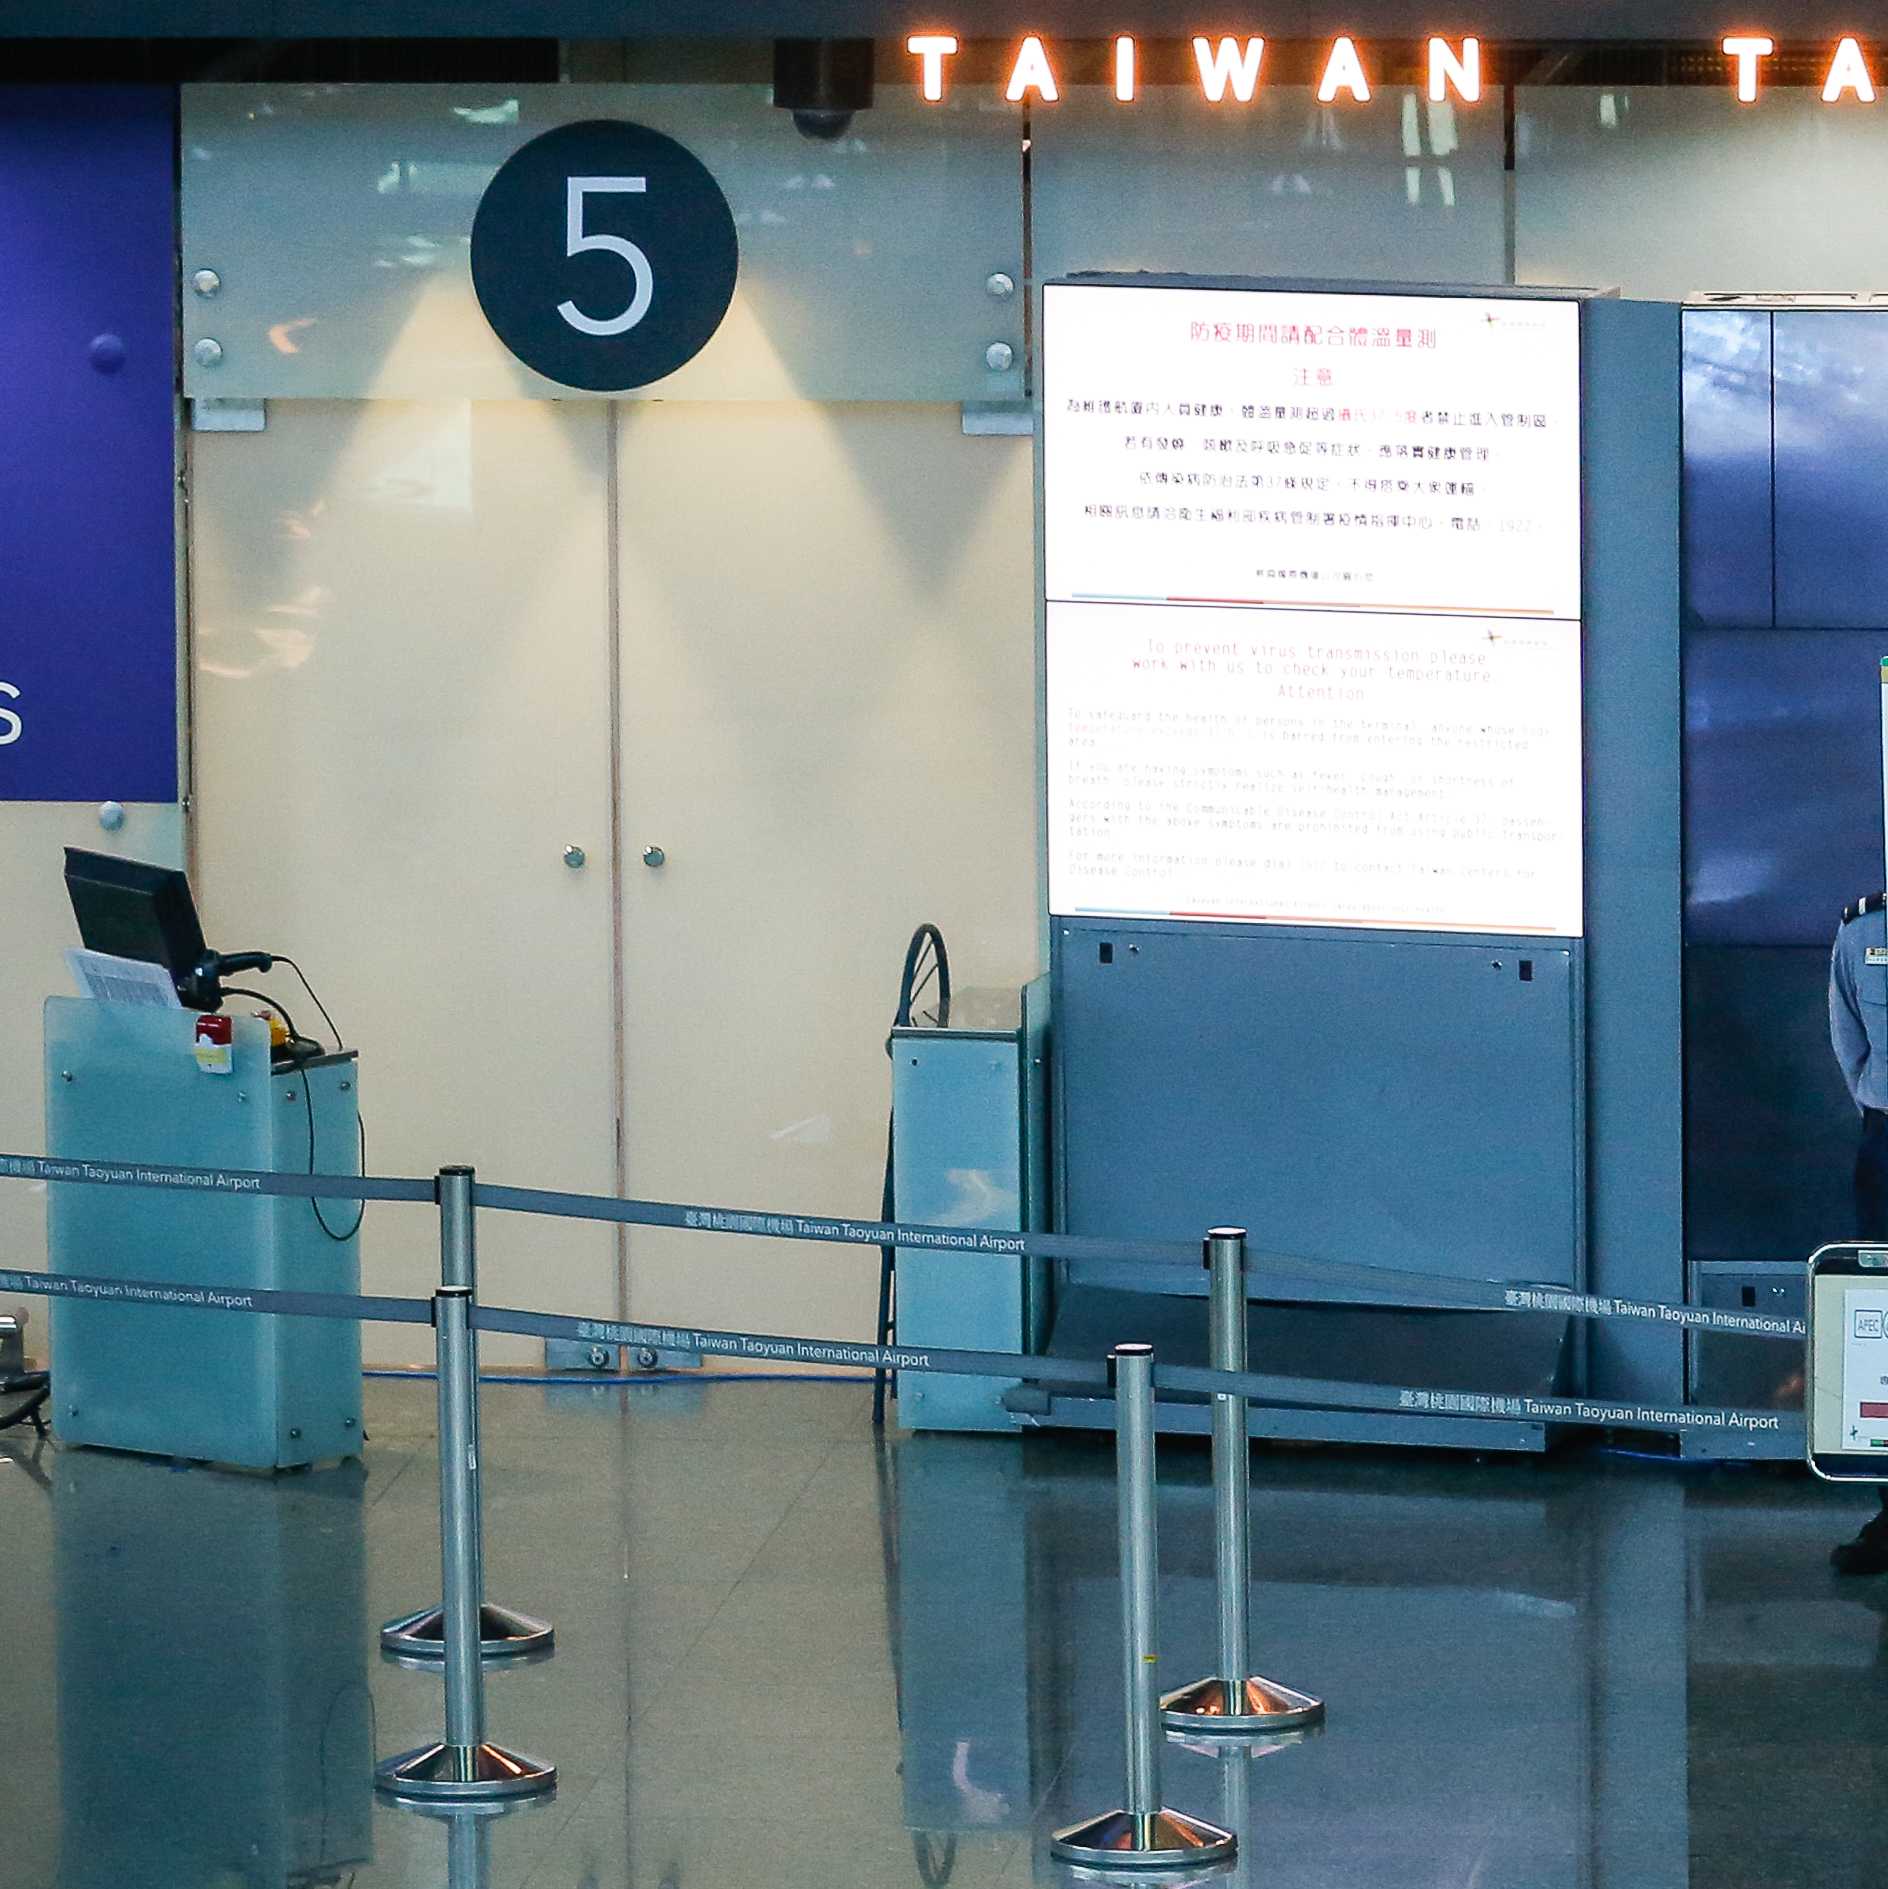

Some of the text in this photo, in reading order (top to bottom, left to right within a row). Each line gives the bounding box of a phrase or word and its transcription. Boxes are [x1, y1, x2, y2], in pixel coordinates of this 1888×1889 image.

[907, 36, 1484, 104] TAIWAN
[557, 176, 653, 335] 5
[37, 1161, 79, 1176] Taiwan
[82, 1164, 134, 1183] Taoyuan
[136, 1169, 214, 1187] International
[216, 1175, 261, 1191] Airport
[1524, 1399, 1572, 1415] Taiwan
[1575, 1403, 1634, 1423] Taoyuan
[1637, 1407, 1725, 1427] International
[1728, 1412, 1779, 1429] Airport
